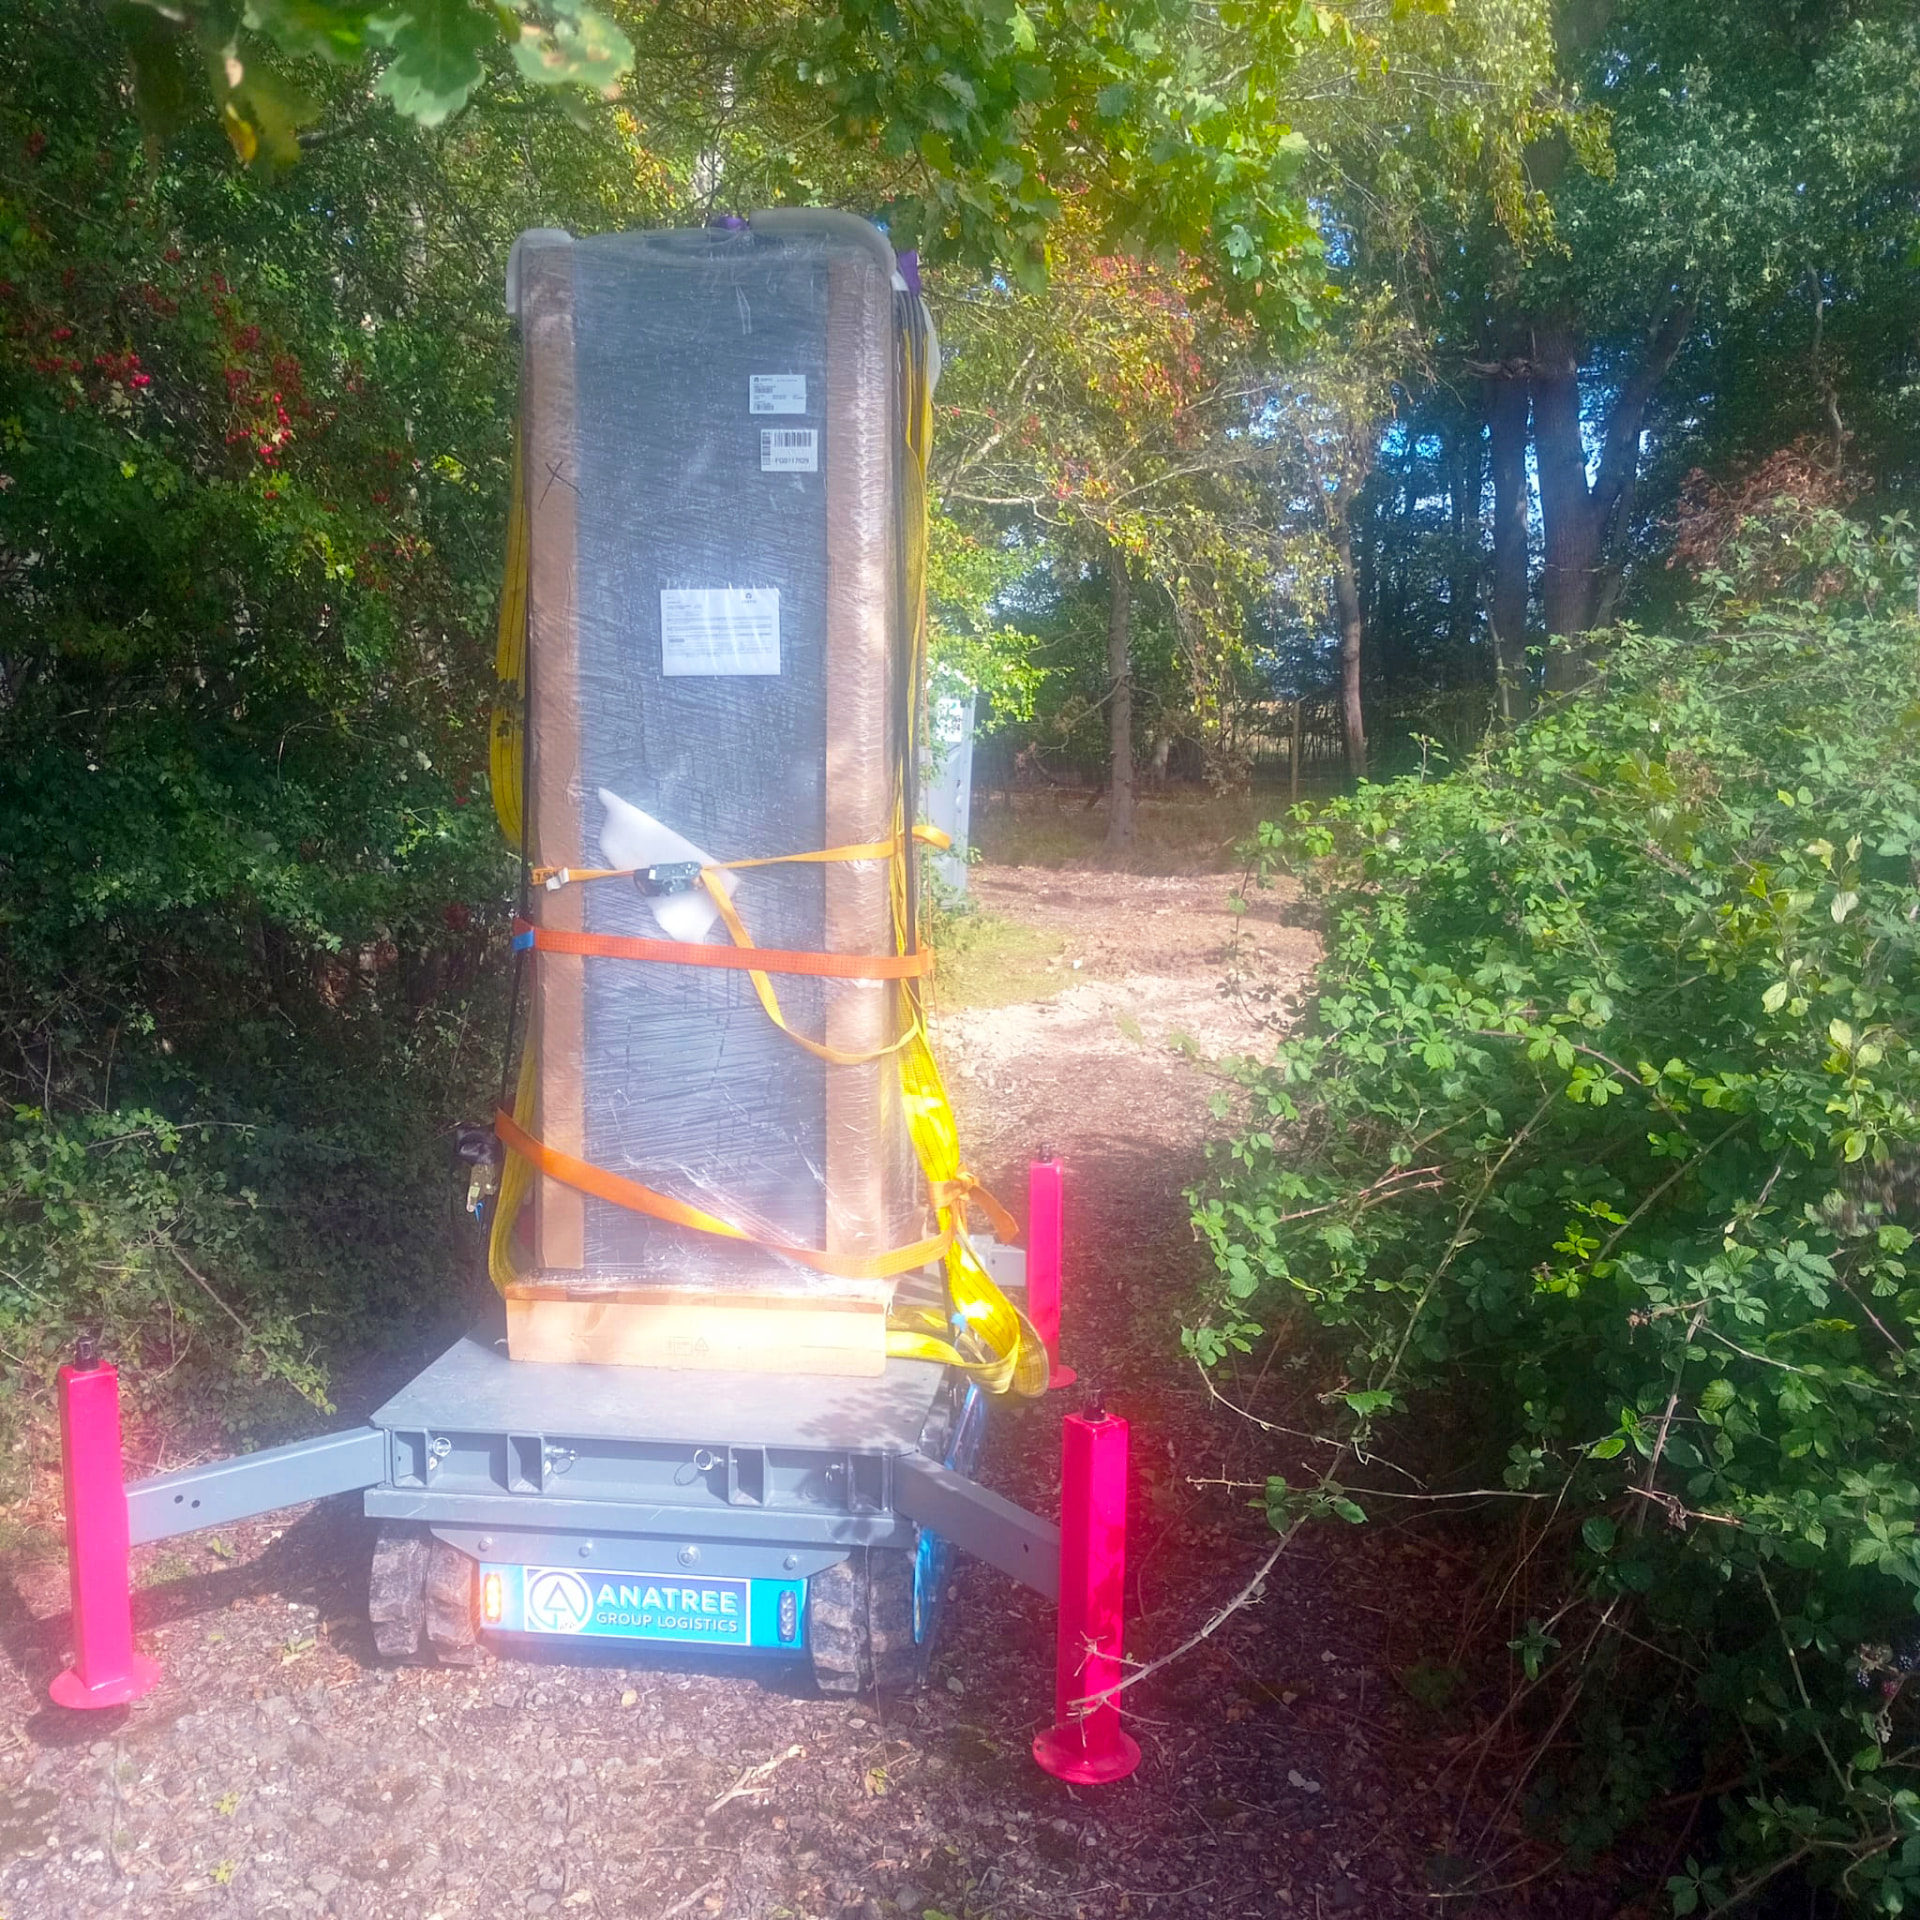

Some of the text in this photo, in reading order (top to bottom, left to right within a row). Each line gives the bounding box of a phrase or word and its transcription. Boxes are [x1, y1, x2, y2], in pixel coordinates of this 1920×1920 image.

[597, 1584, 738, 1615] ANATREE
[596, 1611, 652, 1628] GROUP
[658, 1615, 738, 1633] LOGISTICS
